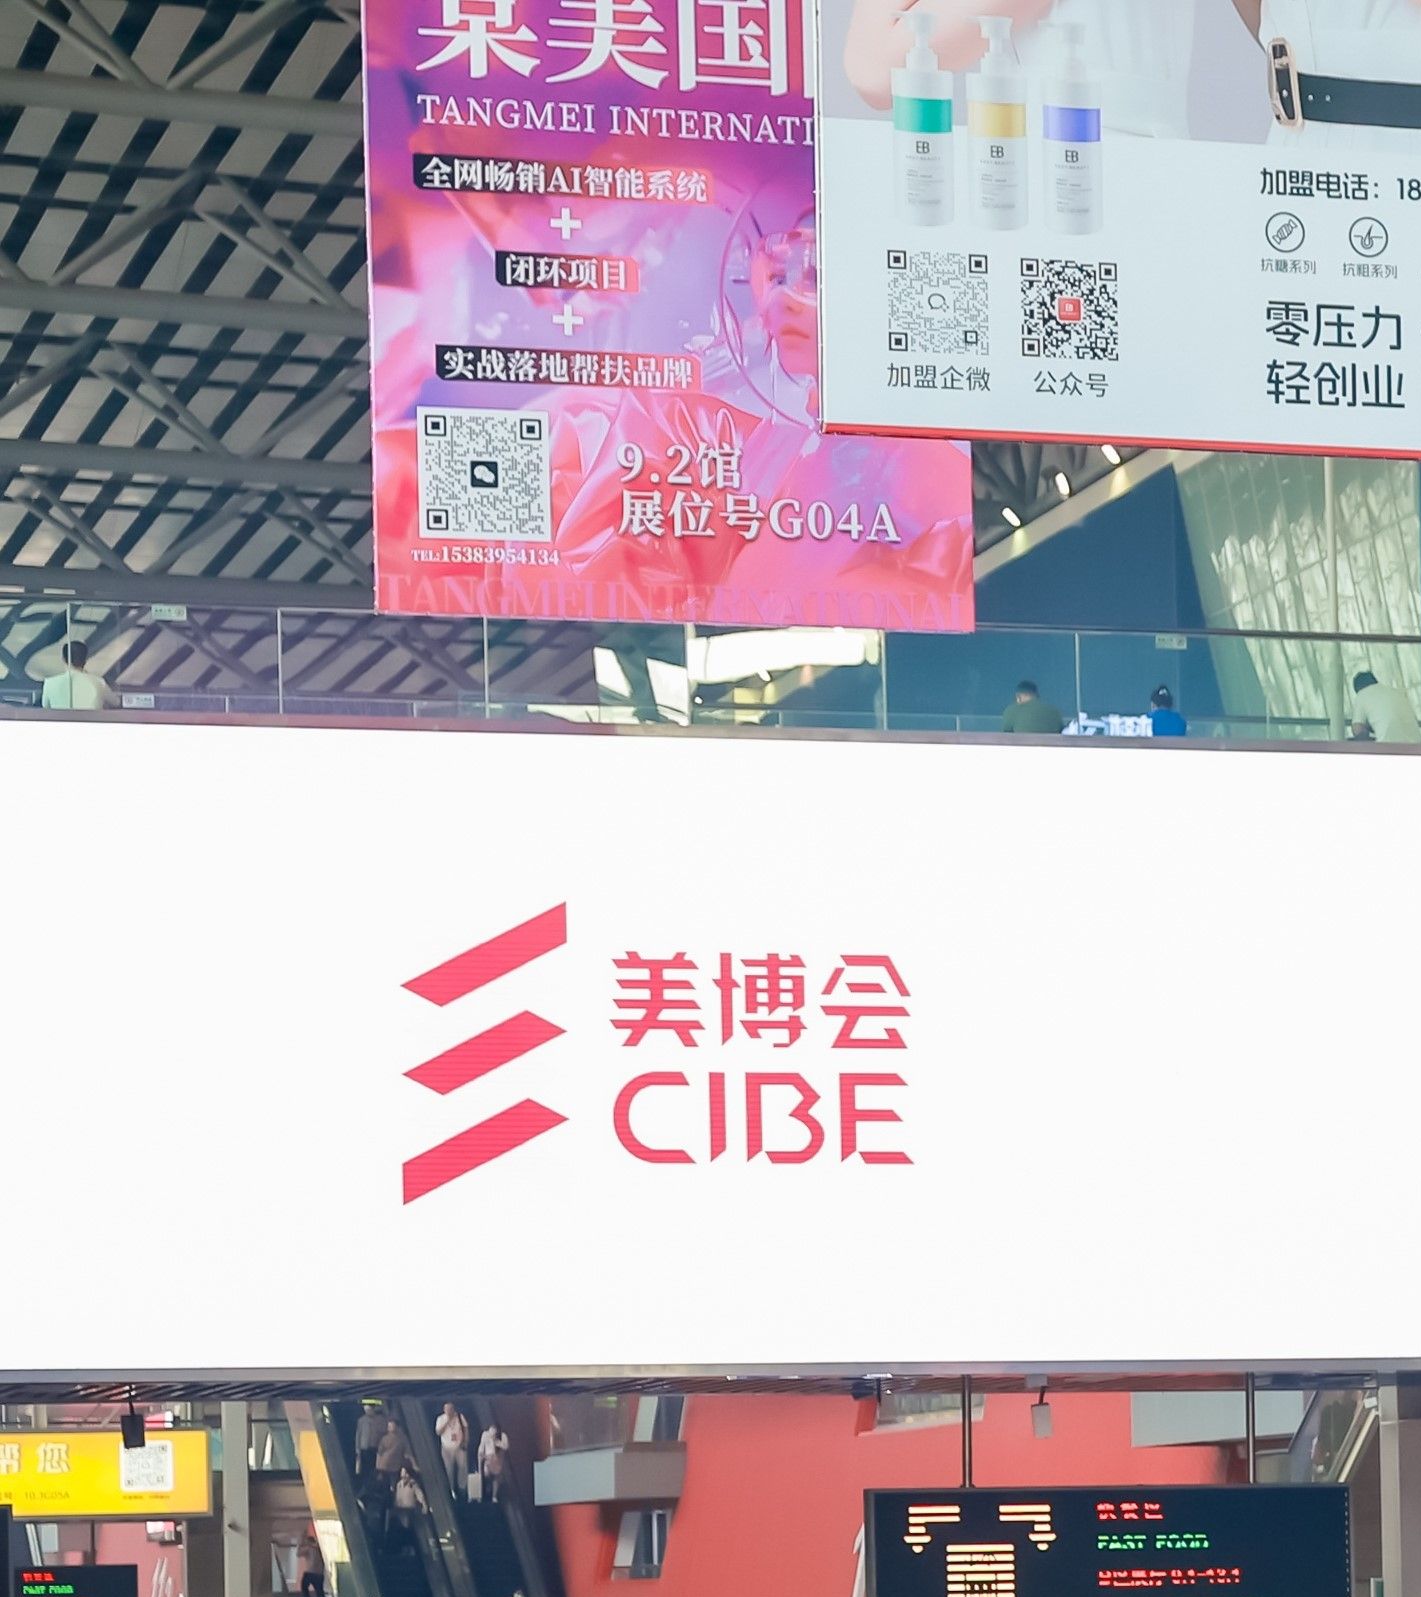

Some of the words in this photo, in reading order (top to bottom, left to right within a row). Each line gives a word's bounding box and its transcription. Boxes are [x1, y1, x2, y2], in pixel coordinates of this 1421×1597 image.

[416, 0, 815, 97] 棠美国
[417, 95, 595, 132] TANGMEI
[420, 157, 709, 203] 全网畅销AI智能系统
[505, 254, 628, 291] 闭环项目
[1265, 300, 1402, 350] 零压力
[443, 350, 694, 389] 实战落地帮扶品牌
[887, 362, 991, 395] 加盟企微
[1033, 368, 1110, 399] 公众号
[1266, 359, 1406, 409] 轻创业
[616, 440, 743, 489] 9.2馆
[618, 491, 902, 544] 展位号G04A
[610, 951, 912, 1049] 美博会
[613, 1071, 915, 1165] CIBE
